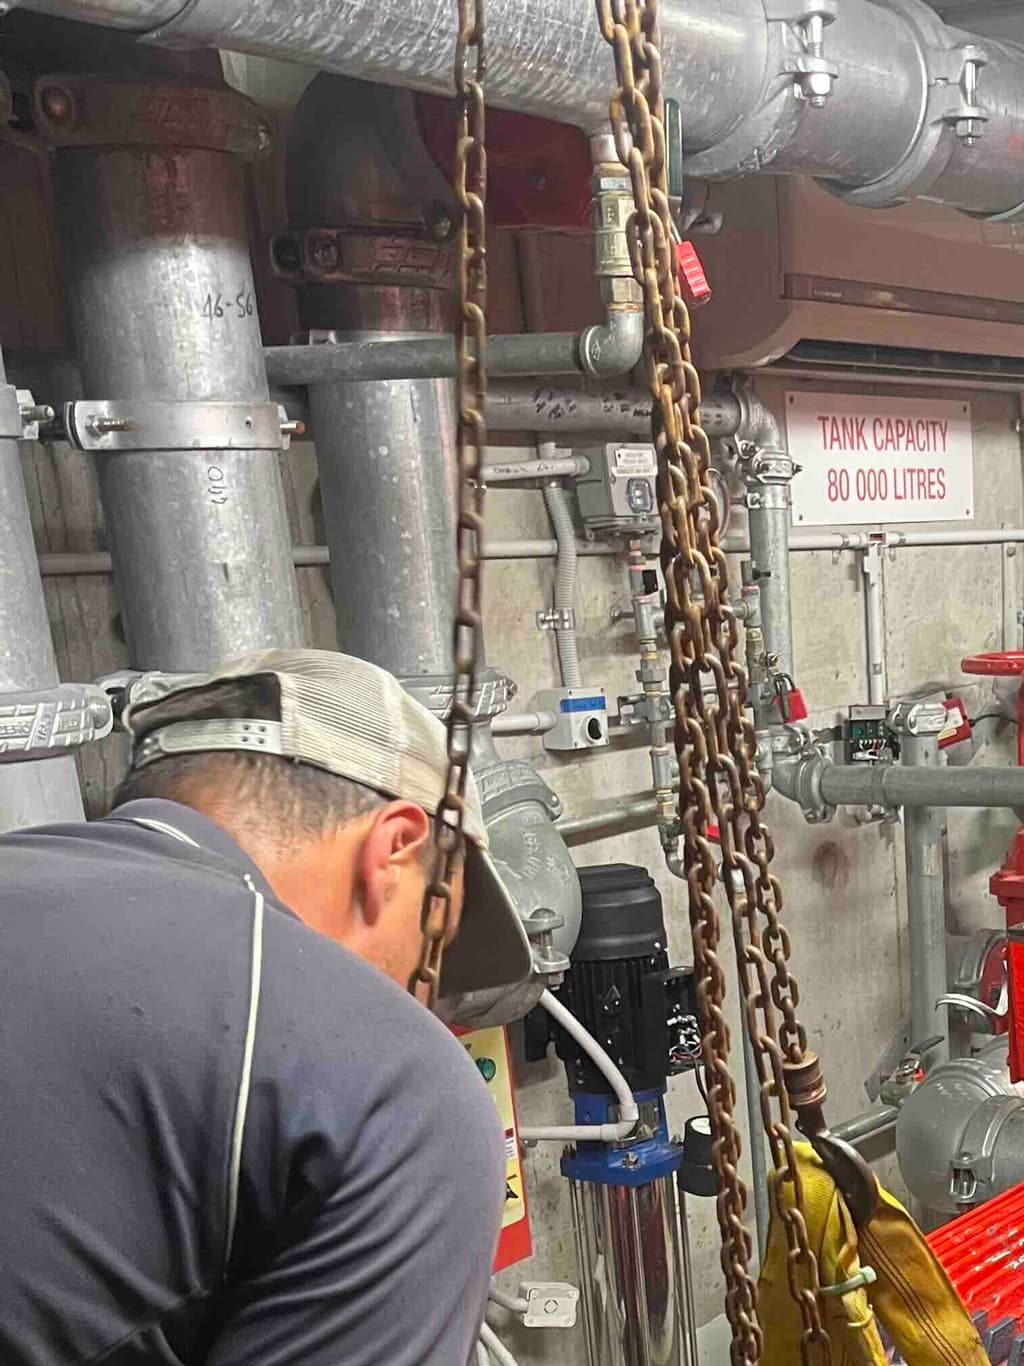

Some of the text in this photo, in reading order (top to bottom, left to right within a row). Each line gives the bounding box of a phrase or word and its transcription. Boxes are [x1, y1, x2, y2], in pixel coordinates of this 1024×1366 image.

[817, 416, 949, 452] TANK CAPACITY
[827, 467, 946, 501] 80 000 LITRES
